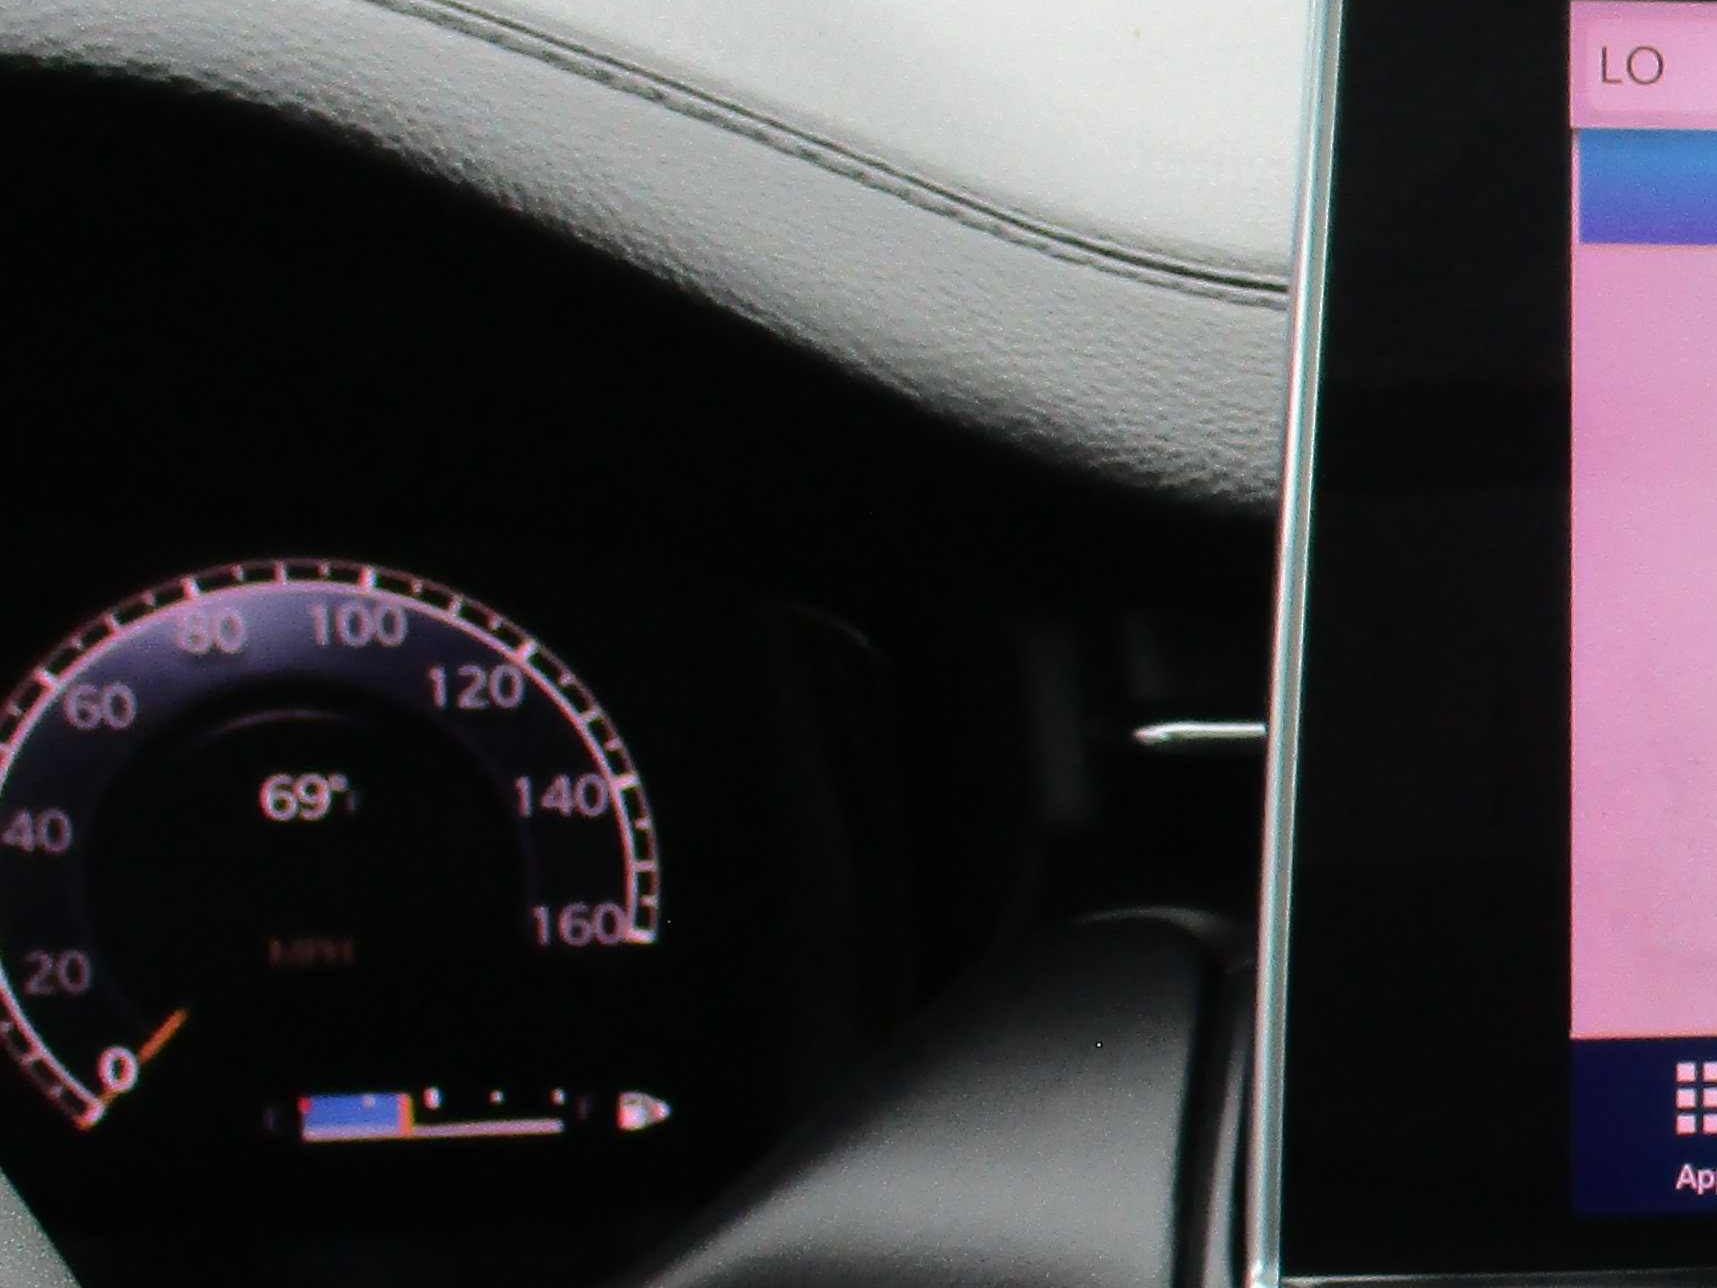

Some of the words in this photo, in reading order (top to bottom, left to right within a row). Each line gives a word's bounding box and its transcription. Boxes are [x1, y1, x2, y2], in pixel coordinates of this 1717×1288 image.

[1601, 45, 1663, 85] LO
[178, 612, 248, 654] 80
[309, 605, 407, 646] 100
[65, 683, 137, 729] 60
[429, 665, 523, 709] 120
[515, 776, 609, 816] 140
[2, 810, 73, 853] 40
[532, 904, 628, 945] 160
[25, 950, 91, 995] 20
[99, 1047, 138, 1093] 0
